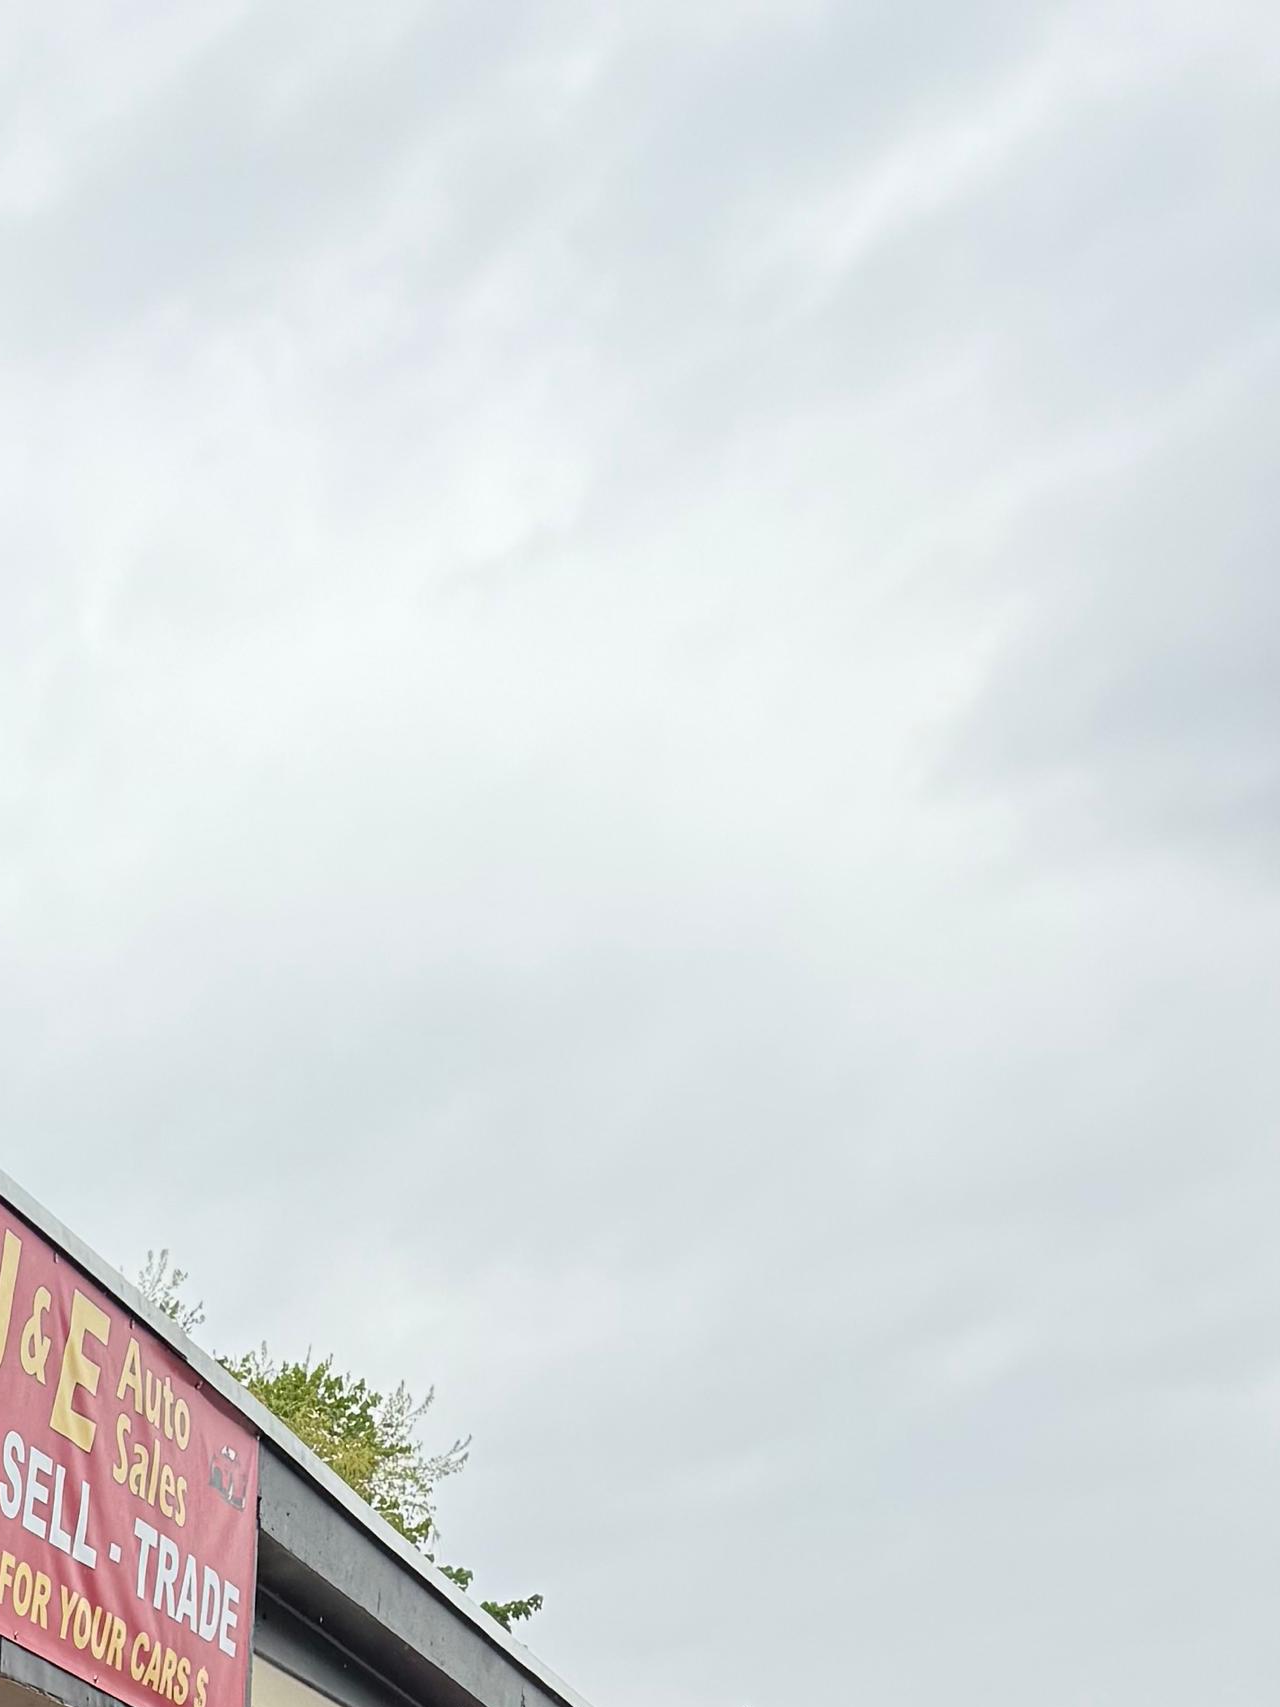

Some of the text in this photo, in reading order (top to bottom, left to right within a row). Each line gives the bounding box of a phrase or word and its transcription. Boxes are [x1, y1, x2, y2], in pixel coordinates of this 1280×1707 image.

[116, 1336, 191, 1451] Auto
[113, 1413, 187, 1527] Sales
[0, 1431, 97, 1570] SELL
[134, 1520, 239, 1658] TRADE
[59, 1586, 126, 1673] YOUR
[130, 1630, 192, 1704] CARS
